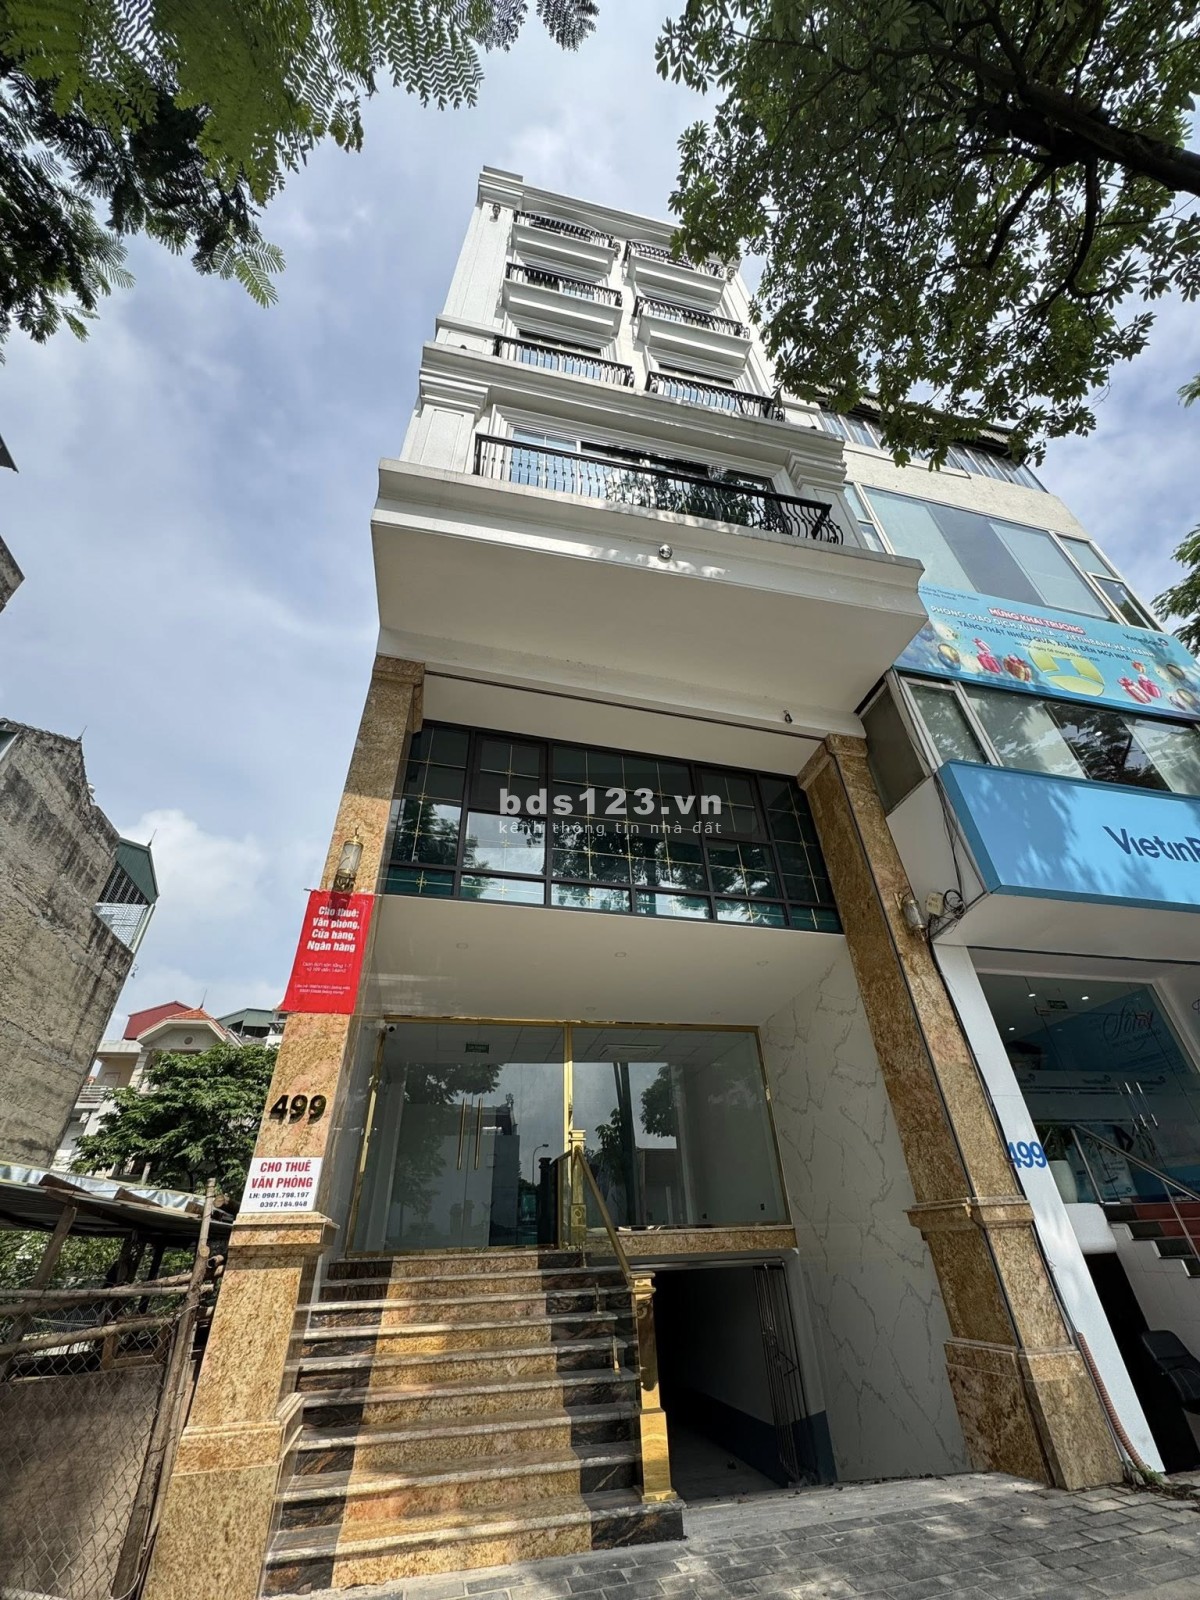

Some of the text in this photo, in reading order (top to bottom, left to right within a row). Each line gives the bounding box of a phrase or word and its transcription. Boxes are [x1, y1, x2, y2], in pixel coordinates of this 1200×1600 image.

[967, 612, 991, 624] GIAO
[1020, 614, 1043, 626] KHAI
[318, 906, 336, 916] Cho
[312, 917, 329, 927] Văn
[311, 928, 330, 939] Cửa
[306, 940, 356, 953] Ngân hàng
[269, 1094, 327, 1125] 499
[1008, 1140, 1047, 1168] 499
[260, 1159, 312, 1173] CHO THUÊ
[251, 1174, 314, 1189] VĂN PHÒNG
